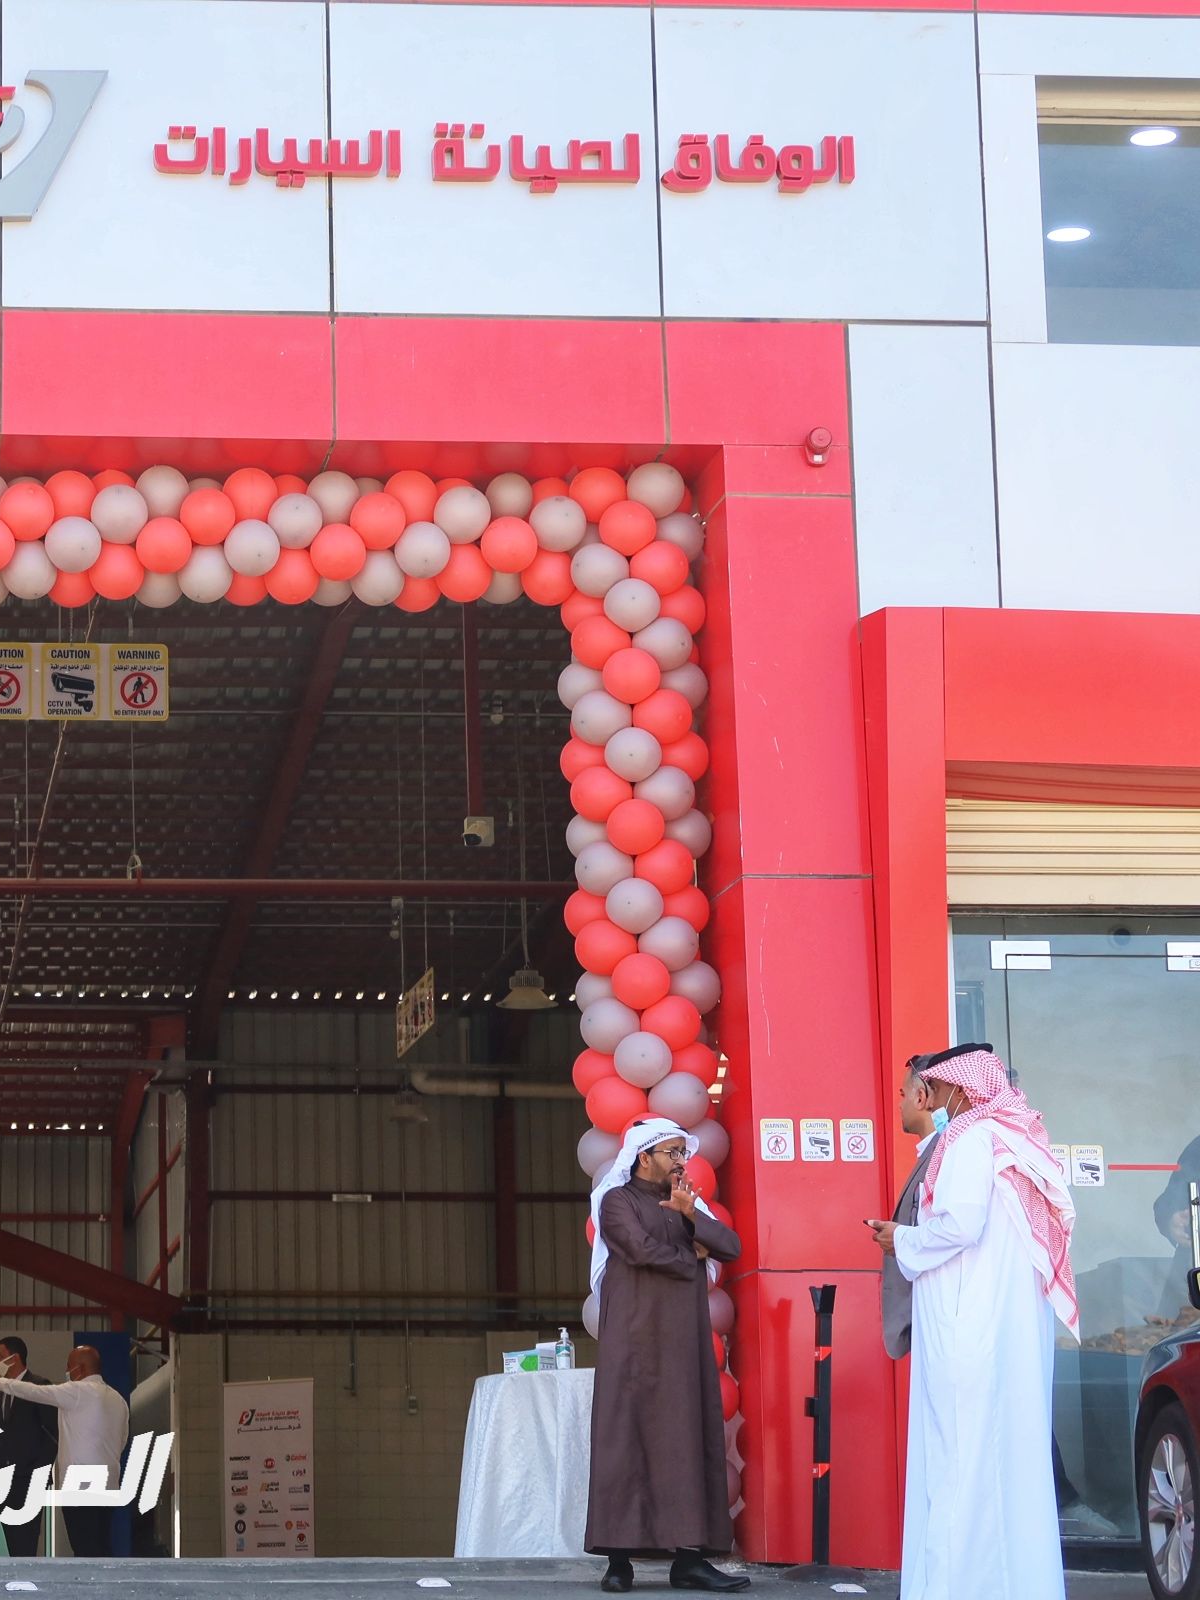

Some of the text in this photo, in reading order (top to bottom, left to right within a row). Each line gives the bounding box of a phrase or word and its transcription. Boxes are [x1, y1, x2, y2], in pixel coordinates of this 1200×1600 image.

[152, 122, 856, 195] الوفاق لصيانة السيارات
[50, 650, 90, 659] CAUTION
[118, 650, 160, 660] WARNING
